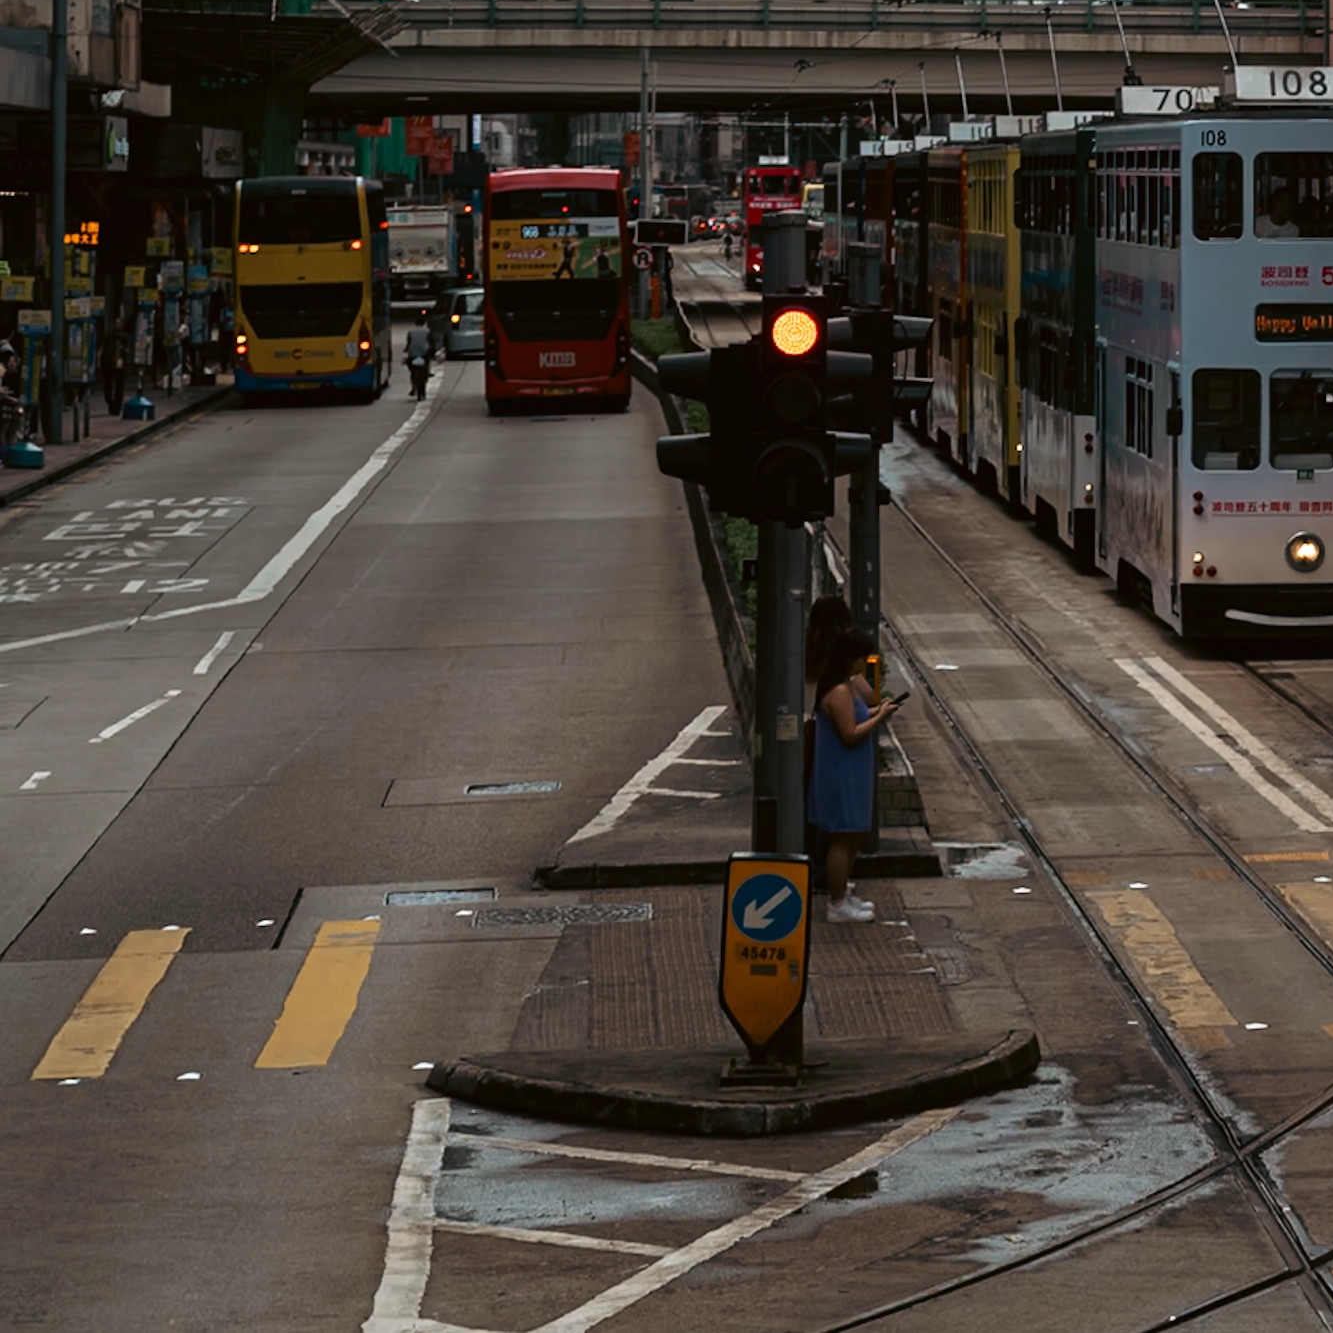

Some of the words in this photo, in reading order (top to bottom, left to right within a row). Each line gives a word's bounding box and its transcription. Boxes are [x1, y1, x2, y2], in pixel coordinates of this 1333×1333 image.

[1270, 71, 1327, 96] 108
[1153, 89, 1192, 111] 70
[1201, 131, 1226, 146] 108
[1261, 266, 1309, 279] 波司登
[1257, 316, 1296, 333] Happy
[741, 947, 786, 960] 45478
